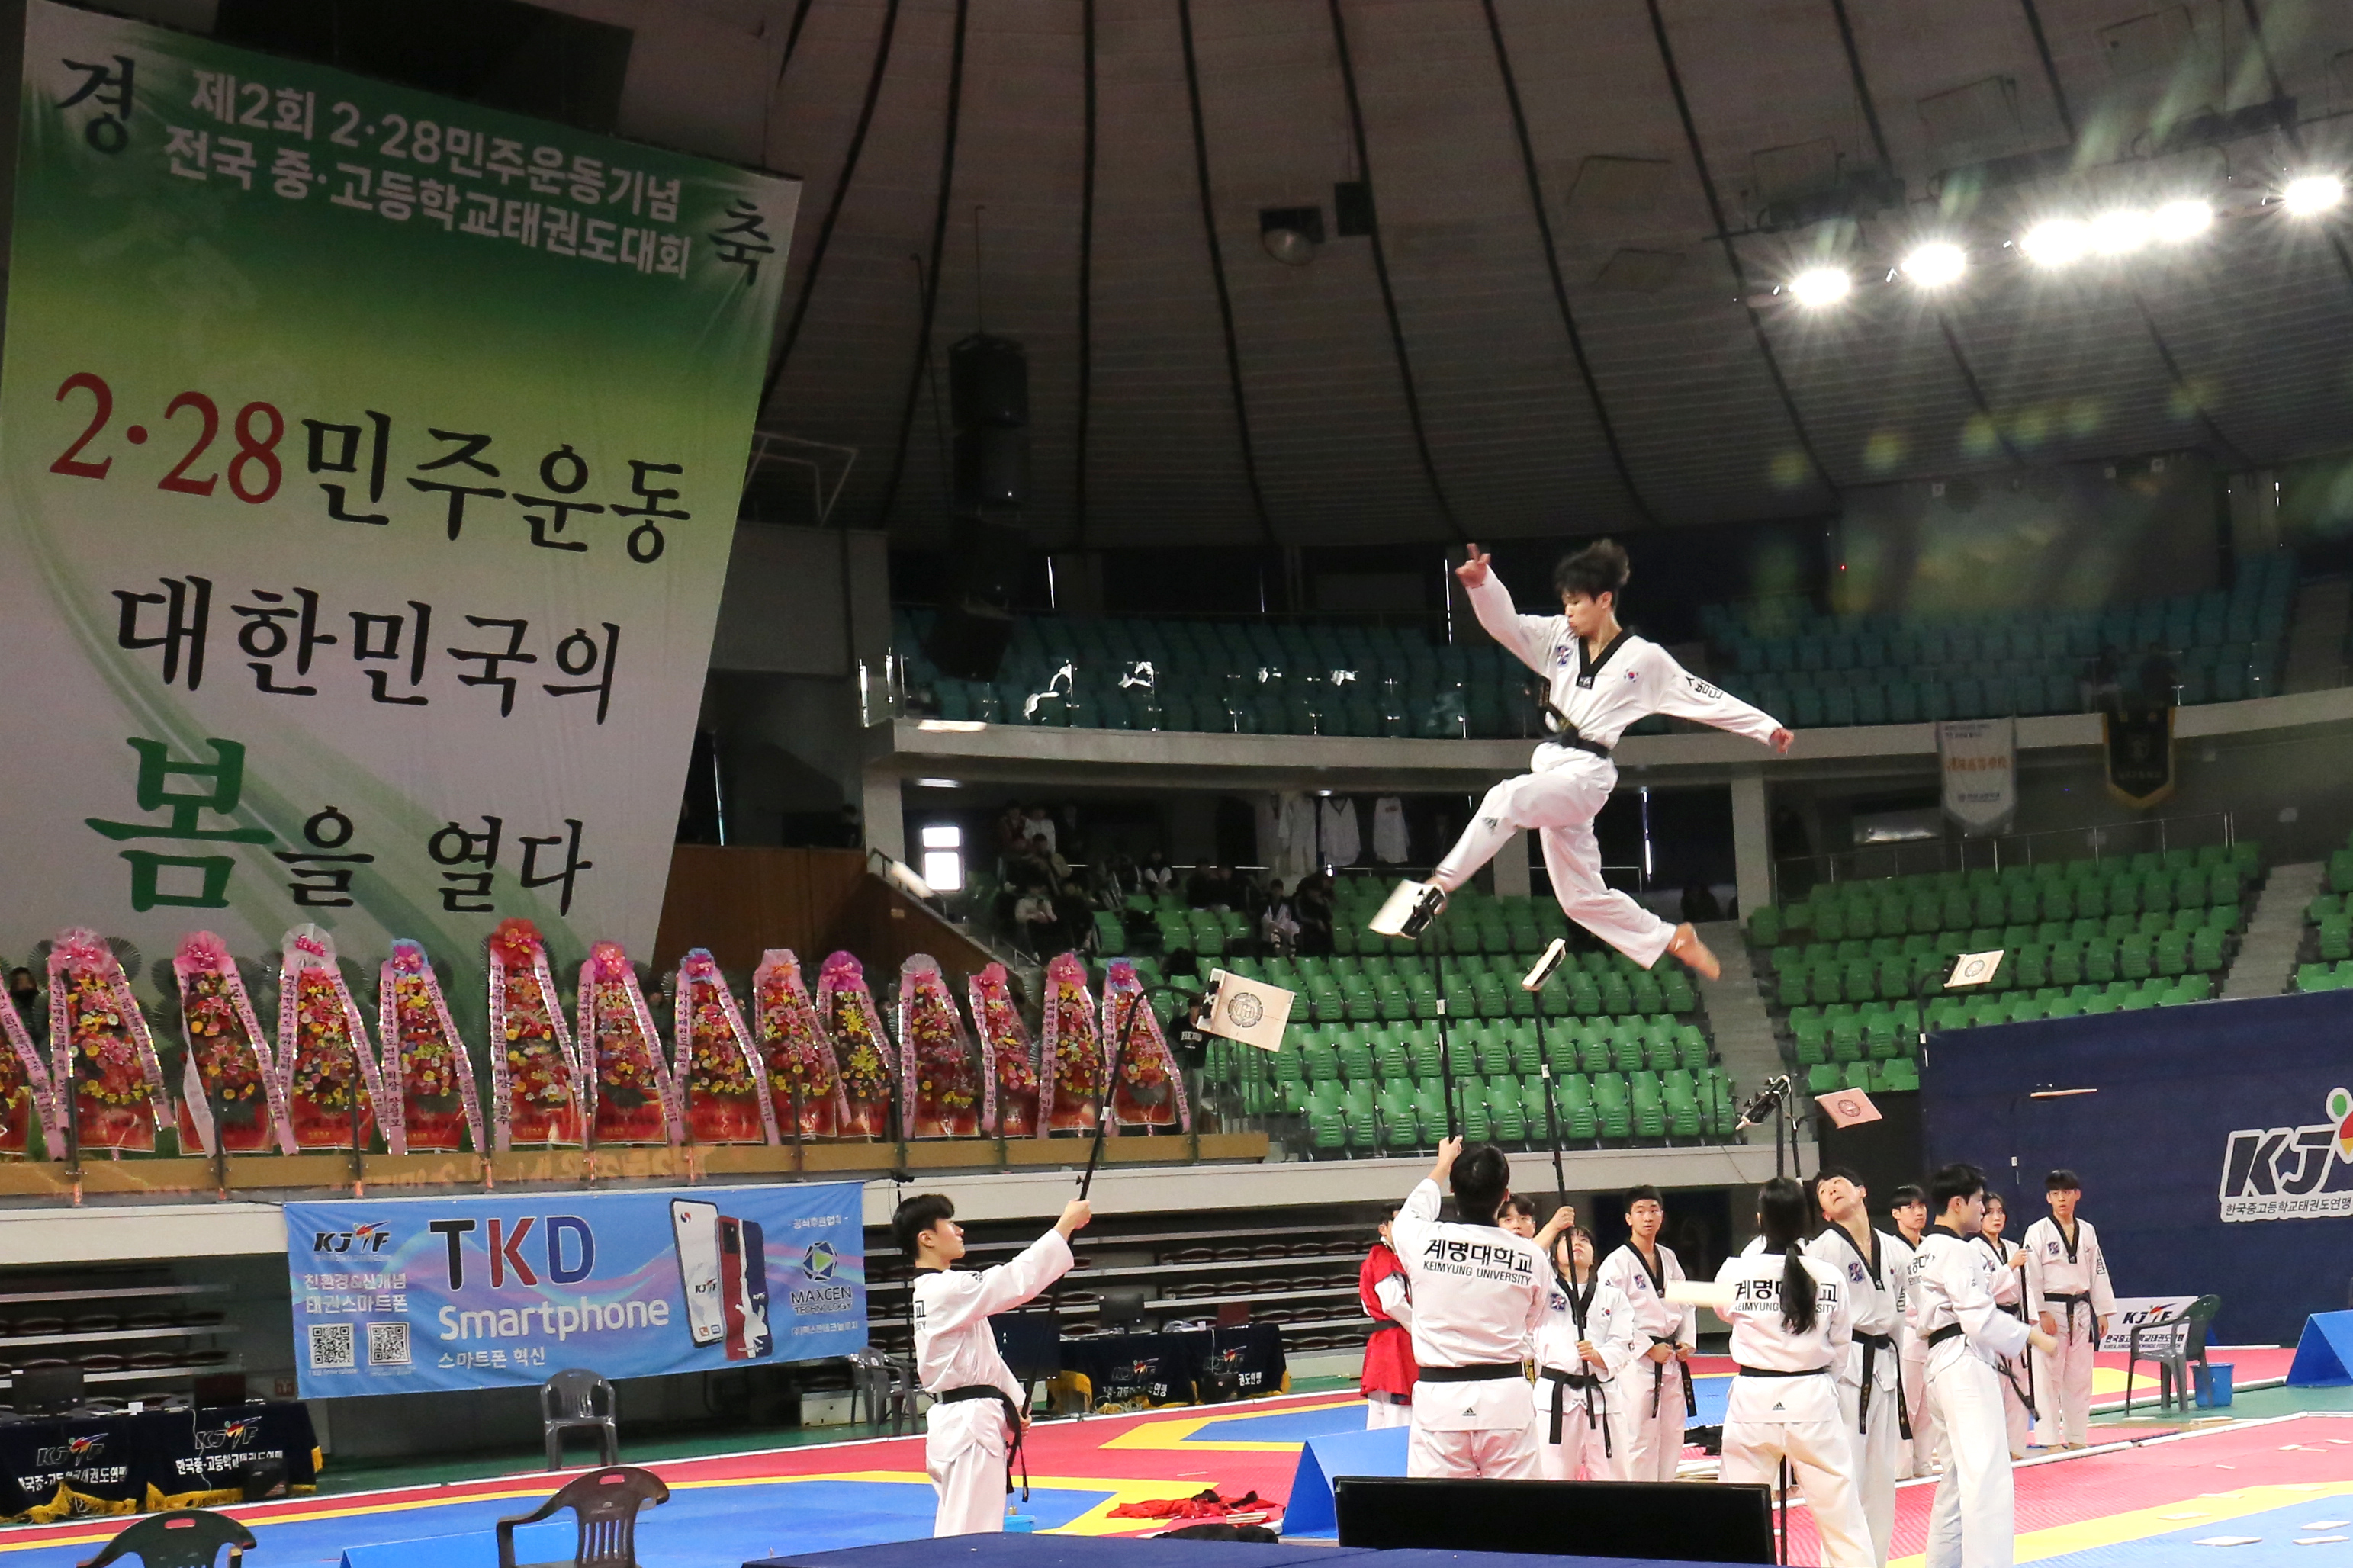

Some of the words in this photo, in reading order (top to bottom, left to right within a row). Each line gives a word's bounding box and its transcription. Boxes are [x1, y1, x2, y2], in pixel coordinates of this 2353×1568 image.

[56, 55, 136, 153] 경
[190, 69, 316, 140] 제2회
[329, 101, 682, 224] 2·28민주운동기념
[162, 125, 258, 190] 전국
[270, 149, 693, 281] 중·고등학교태권도대회
[706, 200, 776, 287] 축
[49, 371, 691, 564] 2·28민주운동
[111, 575, 621, 727] 대한민국의
[85, 736, 374, 912] 봄을
[427, 815, 593, 915] 열다
[2226, 1196, 2351, 1216] 한국중고등학교태권도연맹
[429, 1215, 596, 1291] TKD
[1423, 1239, 1532, 1274] 계명대학교
[1423, 1260, 1473, 1277] KEIMYUNG
[1476, 1268, 1532, 1286] UNIVERSITY
[304, 1273, 407, 1291] 친환경&신개념
[790, 1287, 852, 1304] MAXGEN
[1734, 1279, 1837, 1303] 계명교
[306, 1294, 408, 1313] 태권스마트폰
[439, 1296, 669, 1341] Smartphone
[794, 1302, 852, 1316] TECHNOLOGY
[437, 1349, 507, 1370] 스마트폰
[513, 1346, 545, 1367] 혁신
